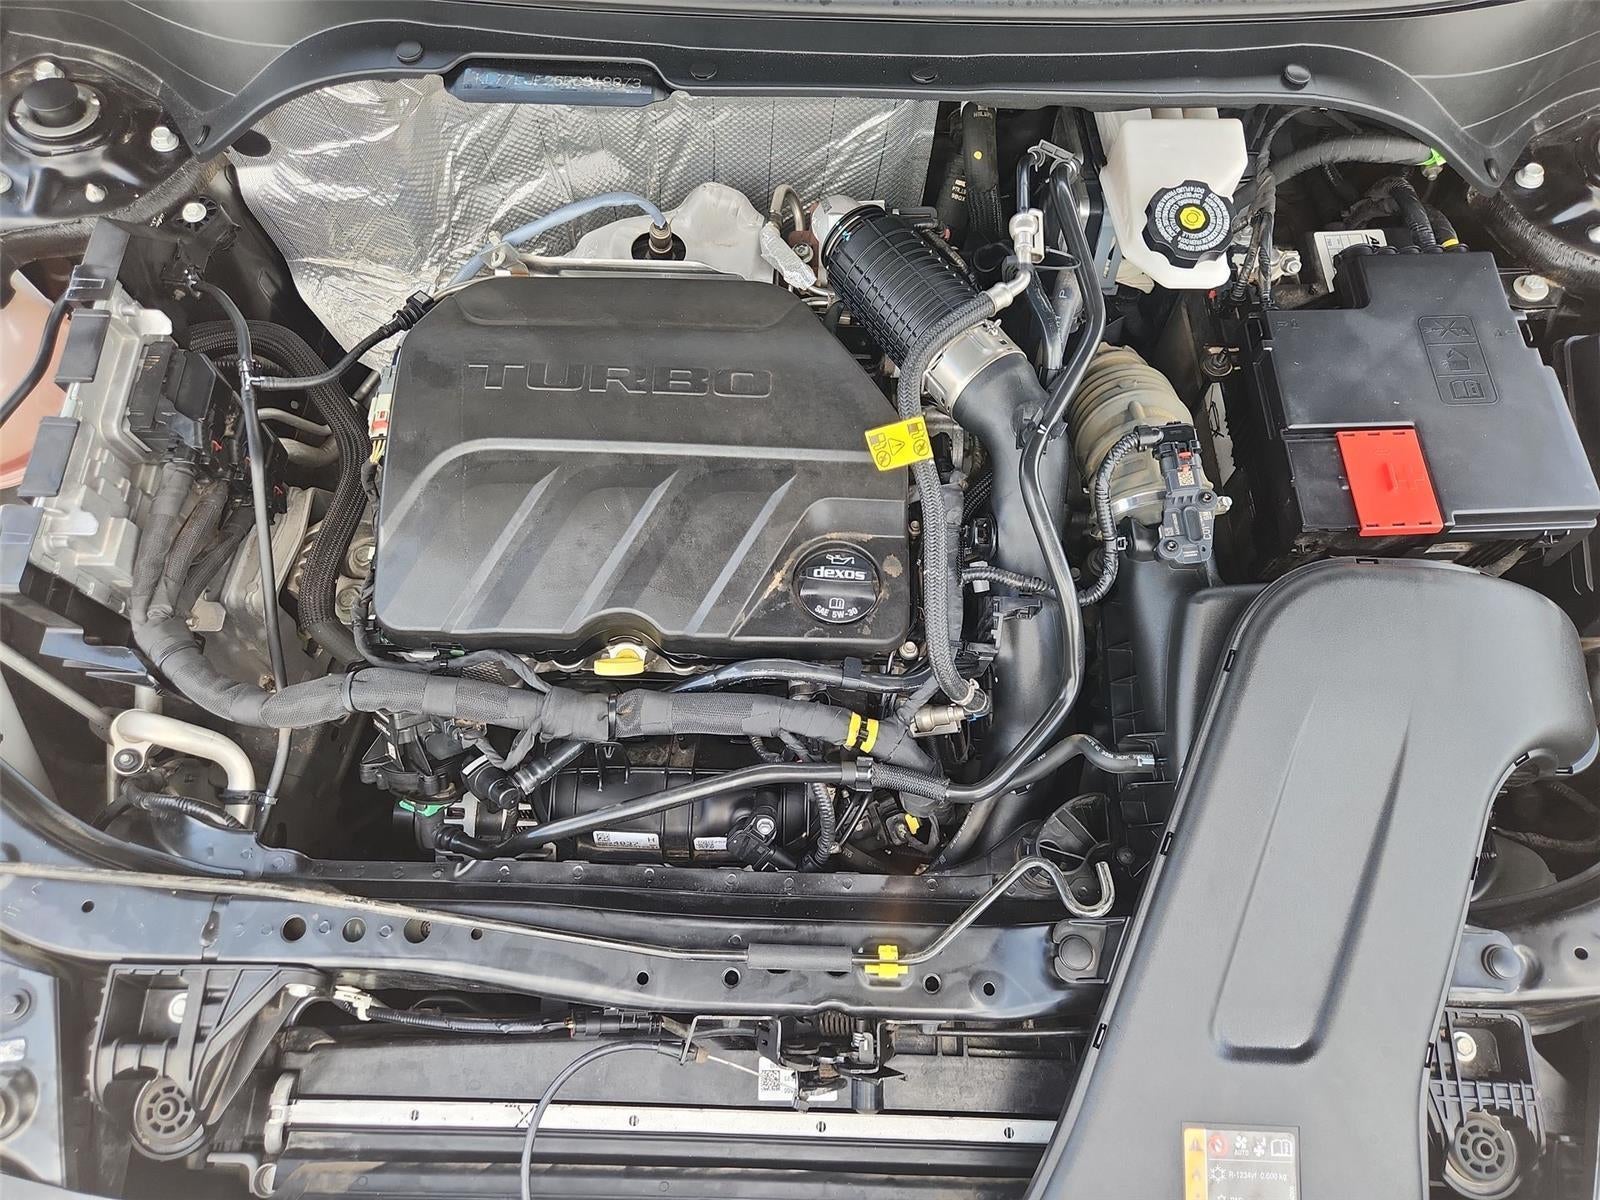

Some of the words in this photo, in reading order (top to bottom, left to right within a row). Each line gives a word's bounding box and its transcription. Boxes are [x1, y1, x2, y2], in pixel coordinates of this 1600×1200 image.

[468, 361, 773, 399] TURBO
[813, 566, 867, 581] dexos
[814, 605, 829, 617] SAE
[832, 607, 859, 619] 5W-30
